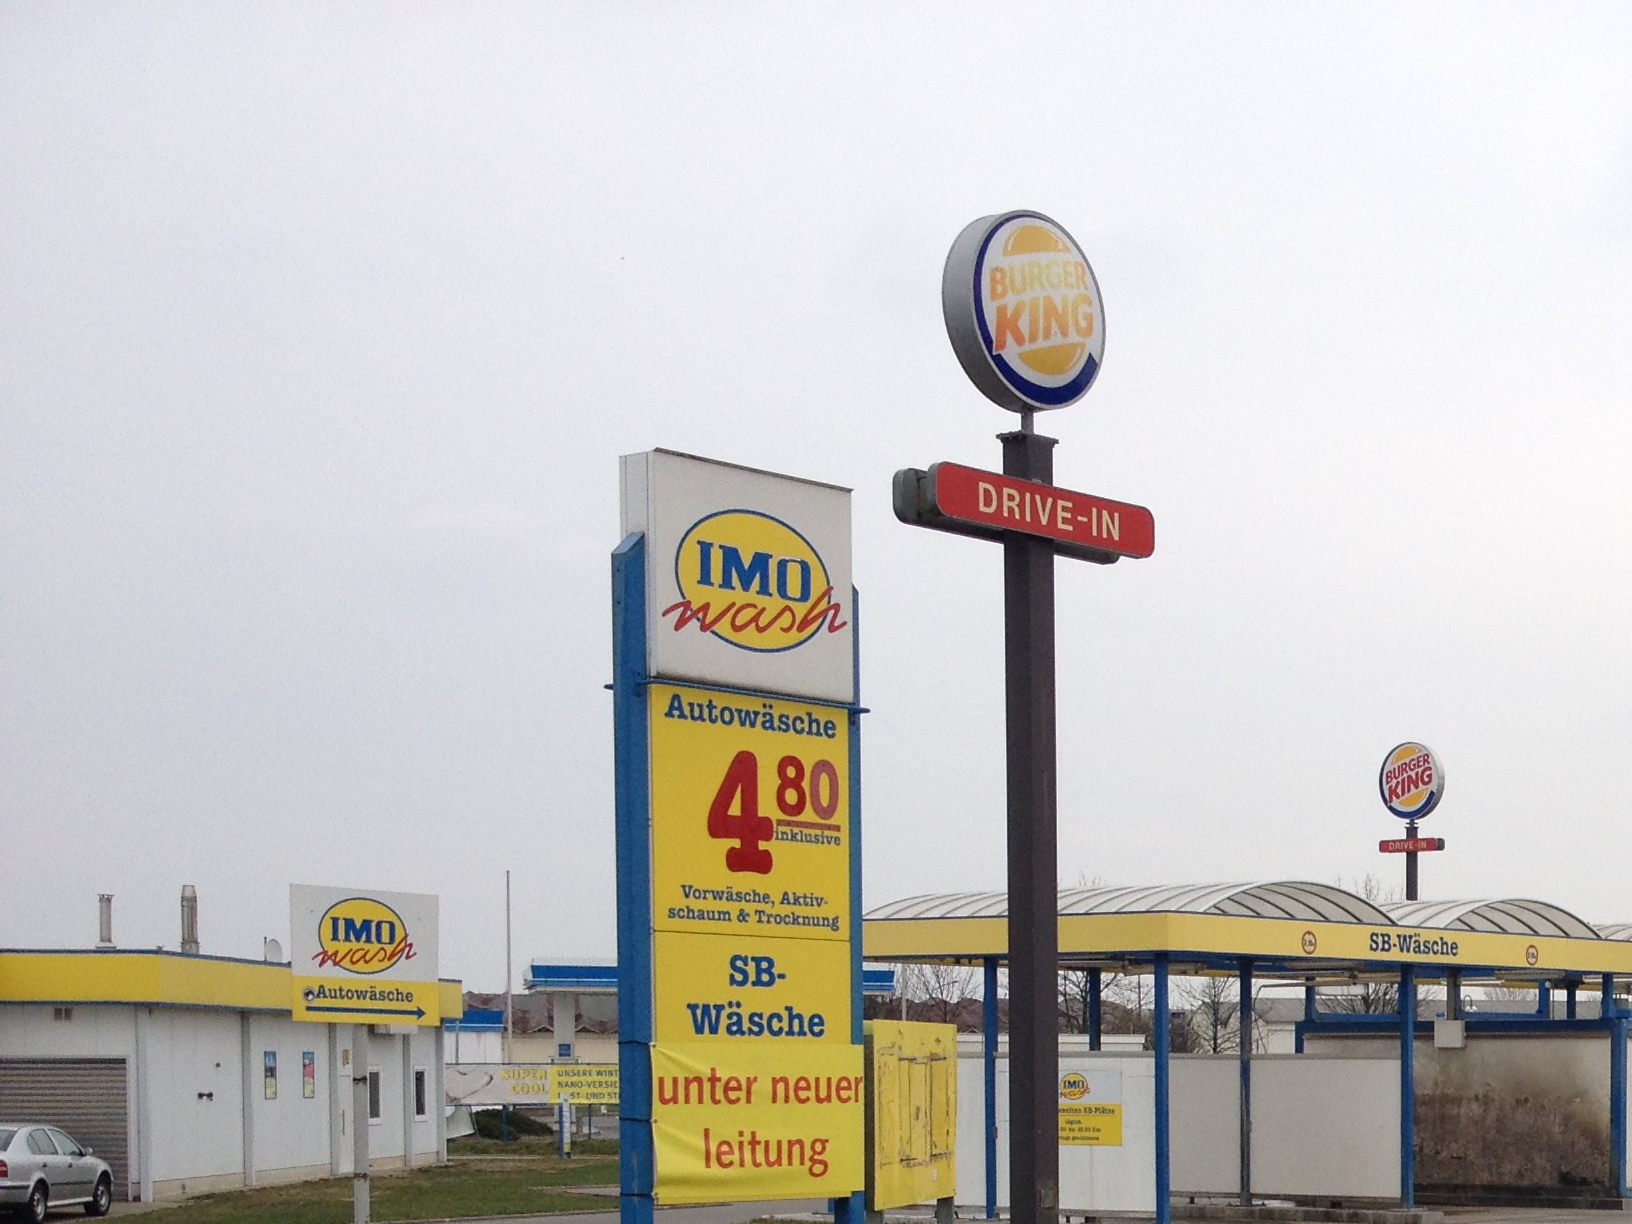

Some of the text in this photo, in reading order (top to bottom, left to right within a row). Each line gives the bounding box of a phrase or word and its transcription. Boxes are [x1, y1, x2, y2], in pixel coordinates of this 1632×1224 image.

[989, 260, 1088, 301] BURGER
[994, 294, 1094, 352] KING
[978, 481, 1120, 541] DRIVE-IN
[696, 540, 811, 603] IMO
[662, 585, 848, 633] wash
[664, 694, 836, 739] Autowäsche
[1385, 753, 1430, 786] BURGER
[1388, 766, 1433, 803] KING
[775, 828, 841, 846] inklusive
[1388, 841, 1427, 851] DRIVE-IN
[681, 884, 828, 907] Vorwäsche, Aktiv-
[330, 917, 396, 945] IMO
[668, 905, 839, 931] schaum & Trocknung
[312, 934, 417, 968] wash
[1369, 932, 1459, 956] SB-Wäsche
[729, 954, 786, 988] SB-
[316, 984, 413, 1002] Autowäsche
[687, 1001, 826, 1037] Wäsche
[501, 1069, 548, 1080] SUPER
[510, 1083, 549, 1095] COOL
[557, 1081, 619, 1089] NANO-VERSIE
[658, 1067, 864, 1105] unter neuer
[1063, 1080, 1085, 1089] IMO
[704, 1128, 829, 1178] leitung
